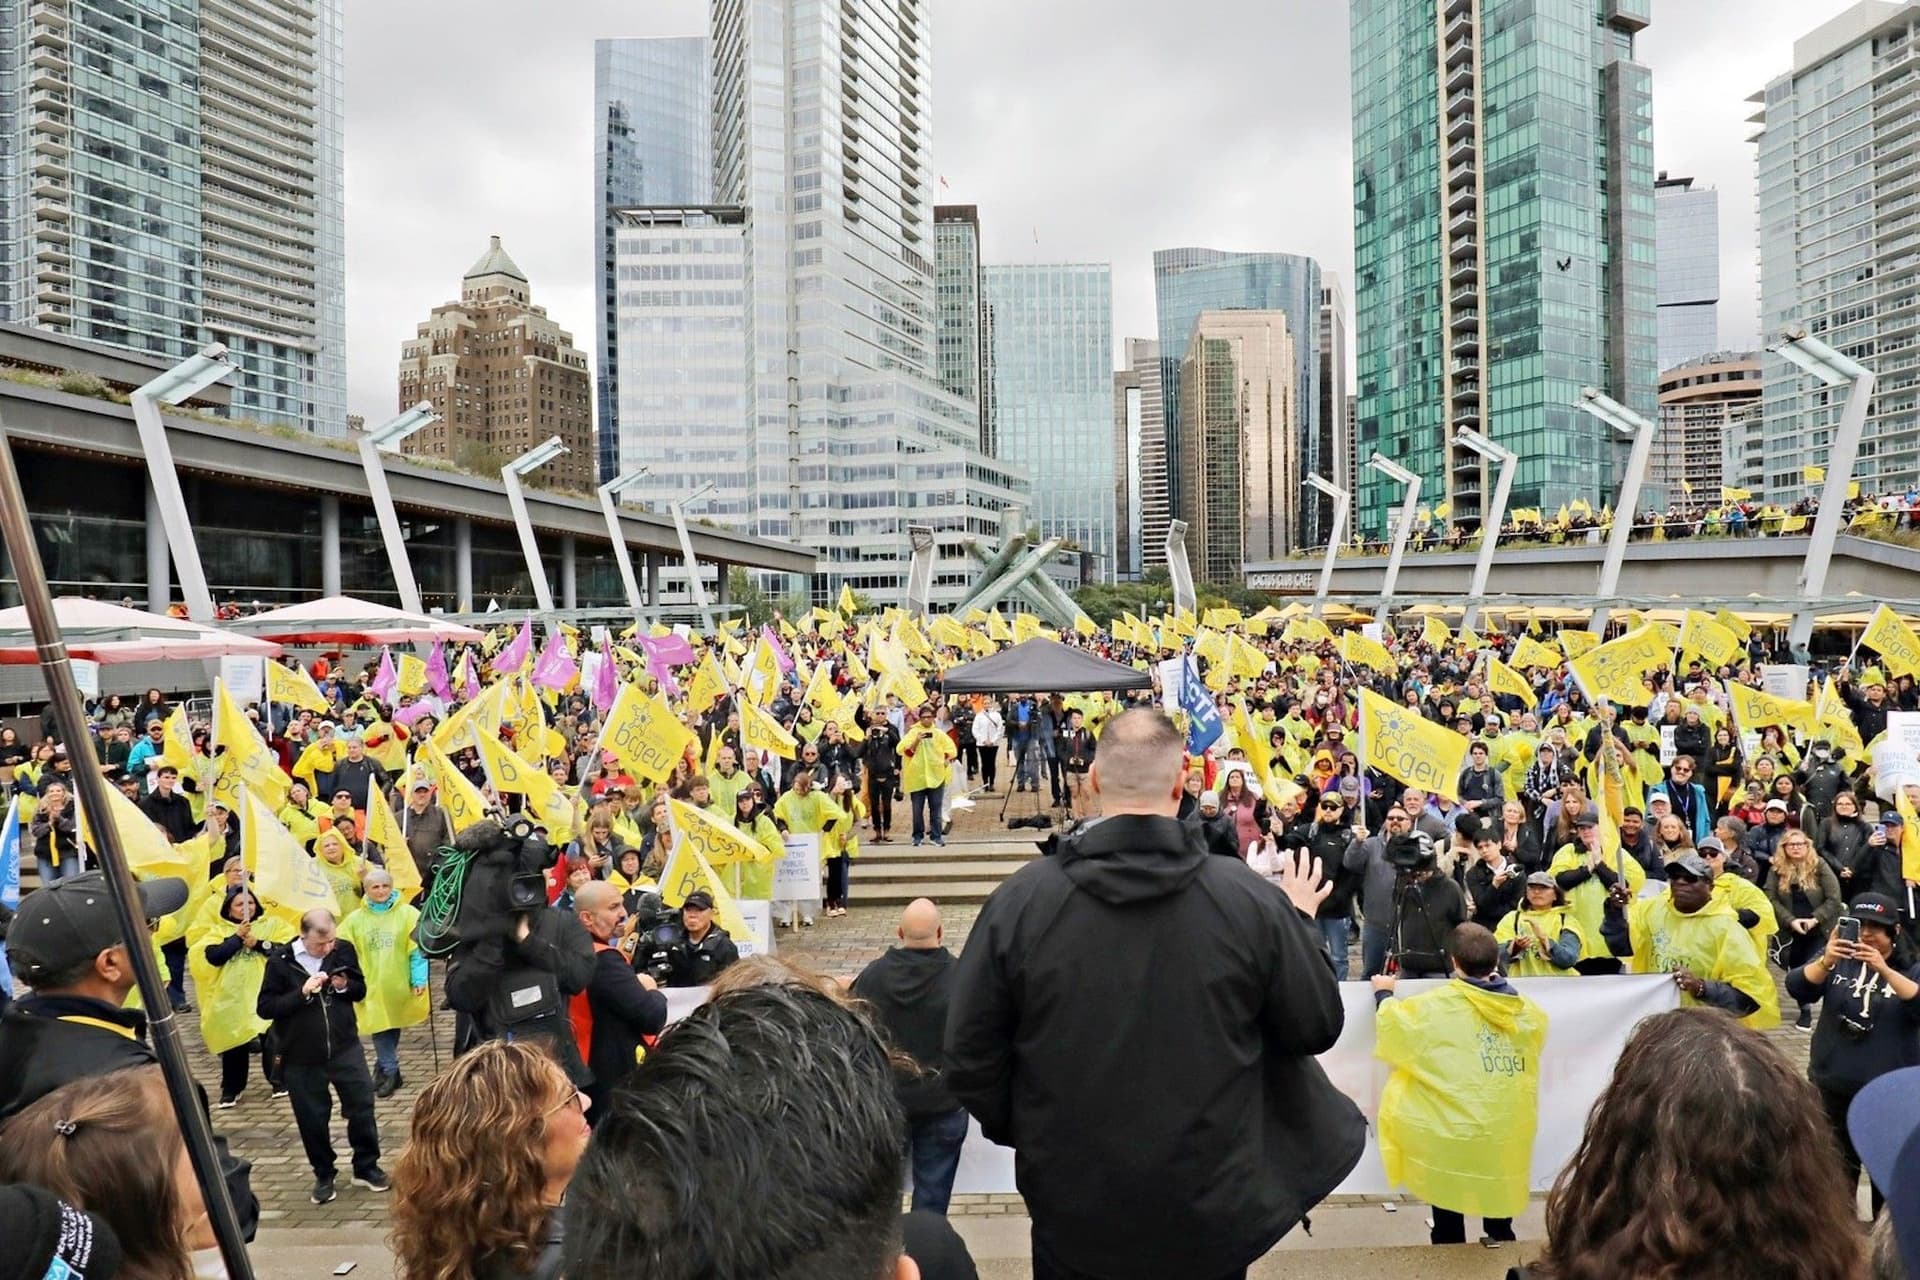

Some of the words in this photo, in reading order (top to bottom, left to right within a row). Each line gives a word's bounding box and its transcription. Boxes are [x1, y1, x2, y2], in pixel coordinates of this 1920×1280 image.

[1253, 574, 1276, 587] CACTUS
[1278, 574, 1293, 587] CLUB
[1295, 573, 1313, 587] CAFE
[614, 722, 670, 770] bcgeu
[1374, 735, 1445, 789] bcgeu
